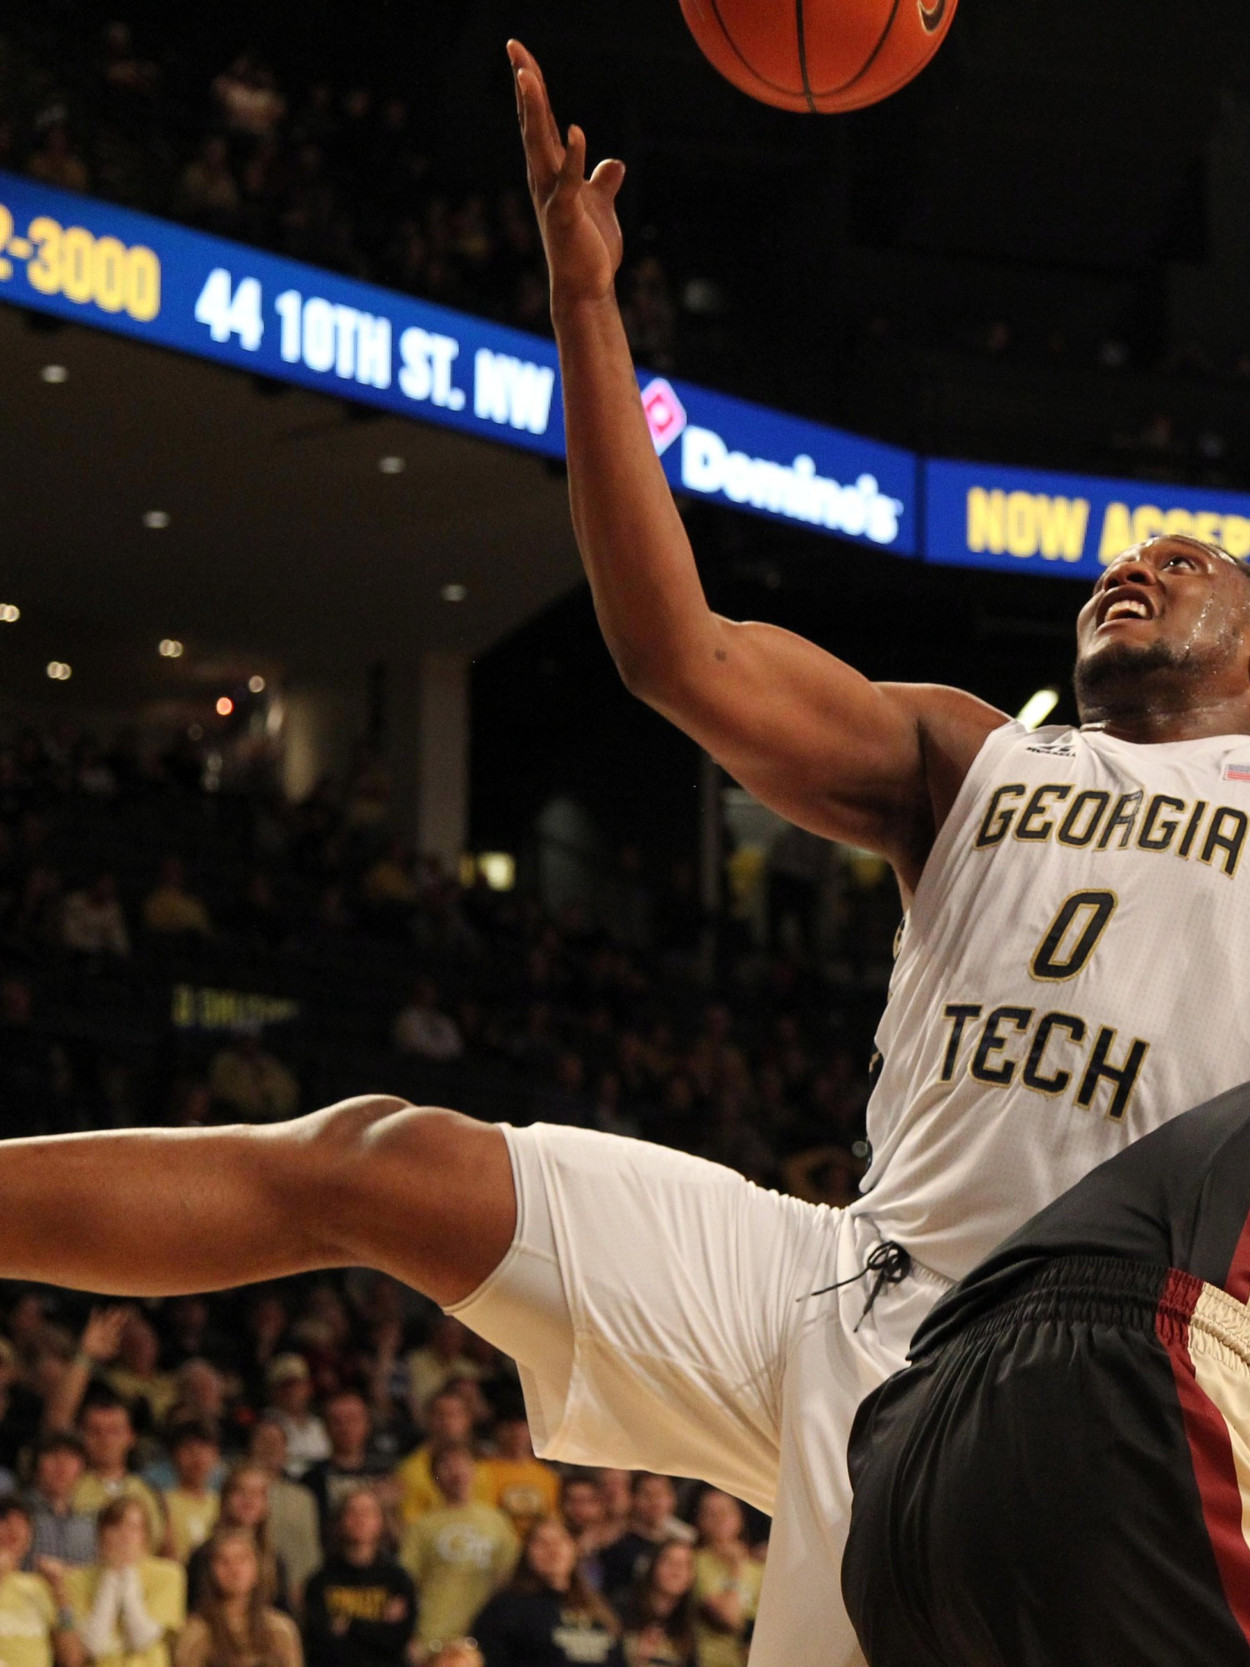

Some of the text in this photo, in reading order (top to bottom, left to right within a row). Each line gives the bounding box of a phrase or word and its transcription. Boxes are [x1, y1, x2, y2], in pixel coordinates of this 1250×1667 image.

[195, 267, 555, 435] 44 10TH ST. NW
[681, 424, 903, 544] Domino's
[966, 485, 1090, 562] NOW
[974, 783, 1250, 879] GEORGIA
[1028, 888, 1118, 983] 0
[939, 1003, 1150, 1122] TECH
